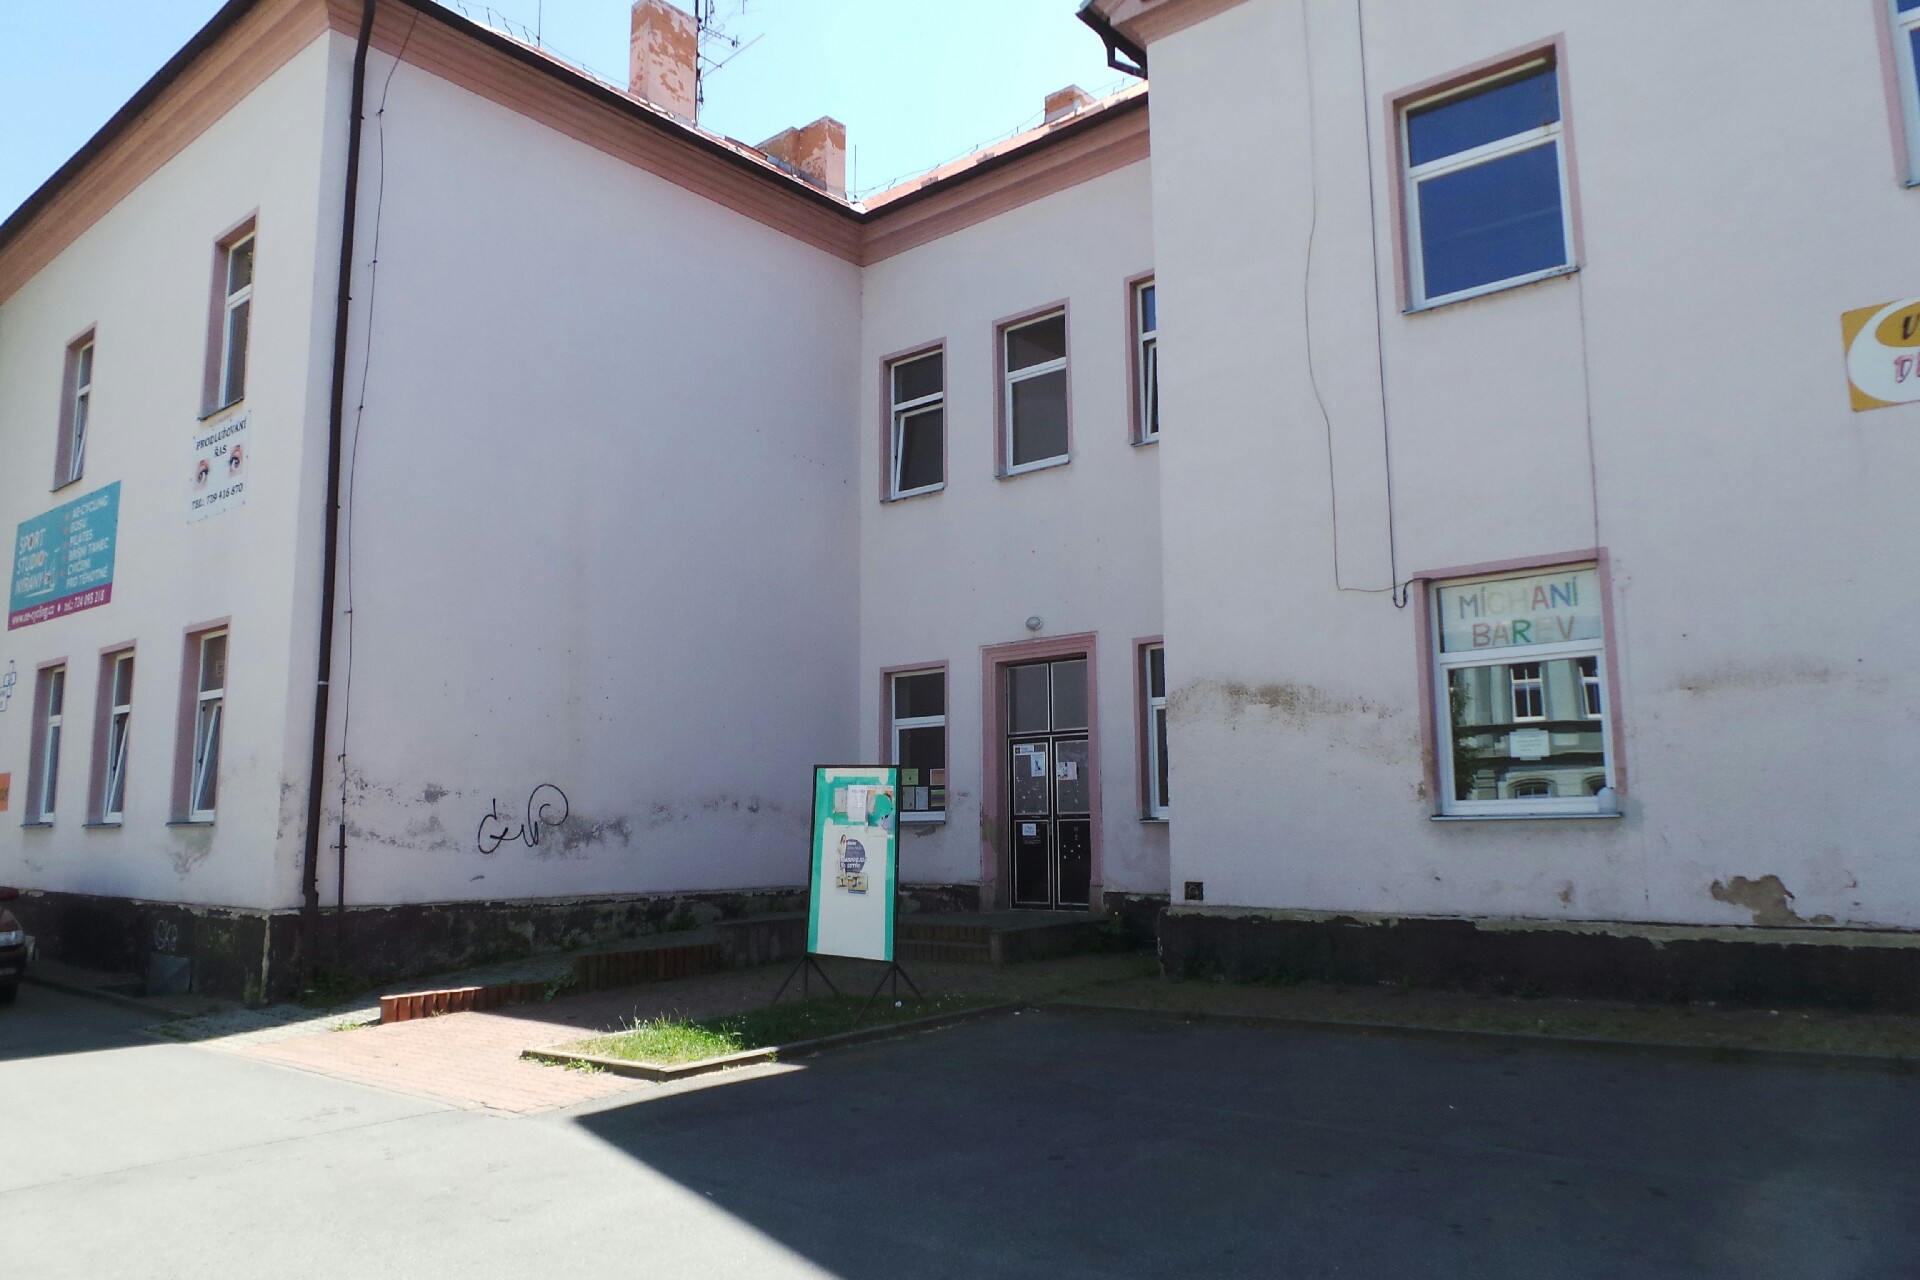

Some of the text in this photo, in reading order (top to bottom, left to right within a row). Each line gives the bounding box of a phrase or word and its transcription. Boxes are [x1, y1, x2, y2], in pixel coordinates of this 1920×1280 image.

[19, 528, 46, 554] SPORT
[17, 550, 45, 575] STUDIO
[1472, 615, 1575, 647] BAREV
